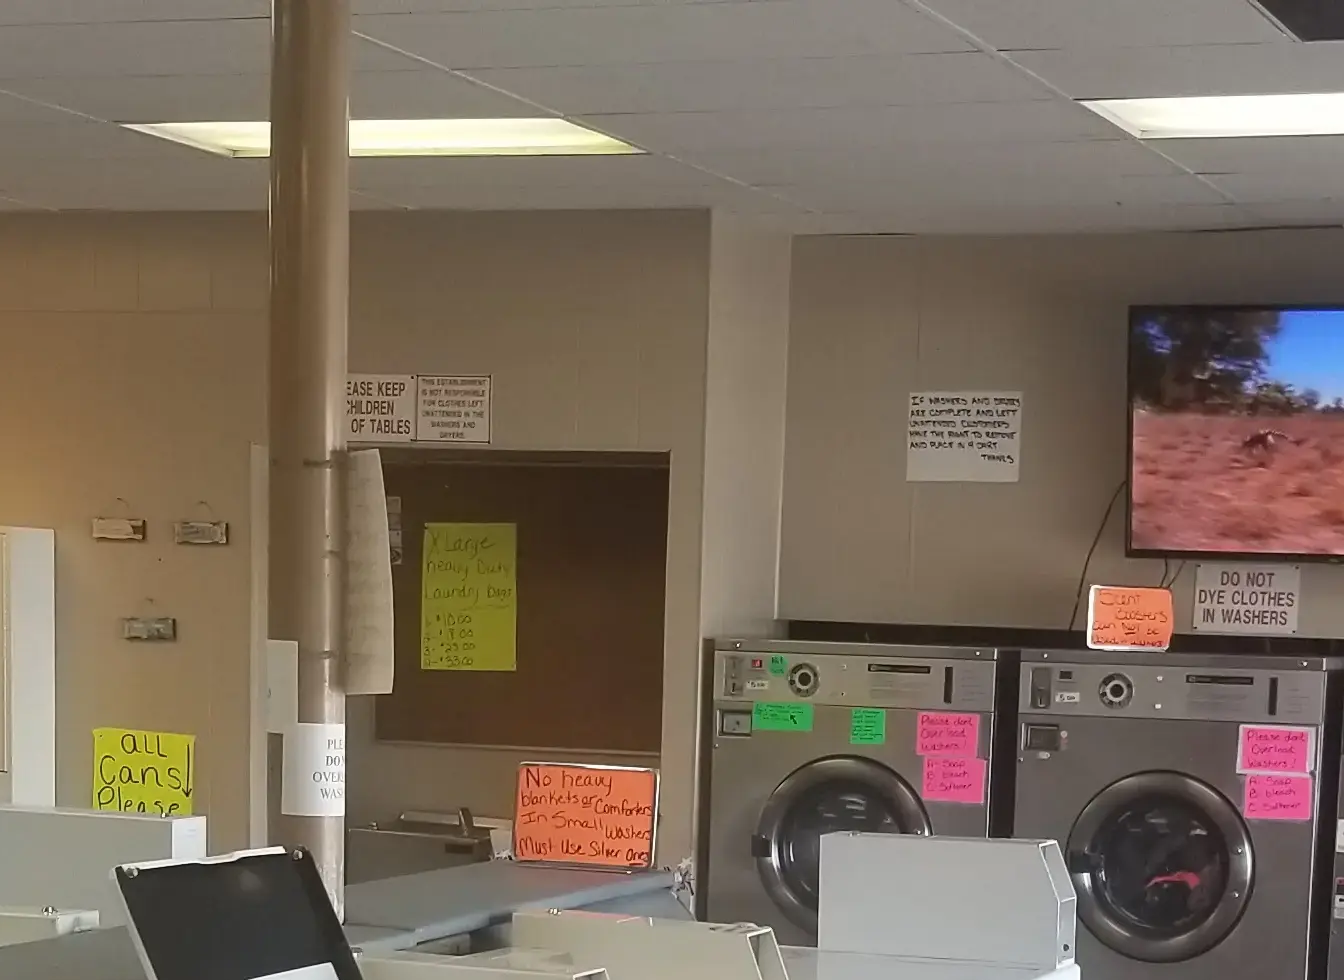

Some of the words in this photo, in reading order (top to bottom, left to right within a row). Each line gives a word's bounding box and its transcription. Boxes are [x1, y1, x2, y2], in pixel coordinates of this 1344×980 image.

[377, 382, 406, 397] KEEP
[351, 419, 366, 433] OF
[370, 419, 411, 435] TABLES
[463, 421, 476, 429] AND
[1221, 571, 1239, 586] DO
[1246, 572, 1274, 586] NOT
[1198, 590, 1225, 606] DYE
[1231, 591, 1295, 607] CLOTHES
[1202, 608, 1215, 624] IN
[1221, 610, 1288, 626] WASHERS
[1247, 730, 1280, 742] Please
[100, 755, 181, 790] Cans
[526, 768, 552, 788] No
[562, 770, 612, 797] heavy
[97, 786, 180, 813] Please
[521, 791, 578, 807] blankets
[521, 811, 547, 825] In
[552, 811, 603, 830] Small
[519, 837, 554, 857] Must
[561, 839, 586, 855] Use
[588, 841, 620, 857] Silver
